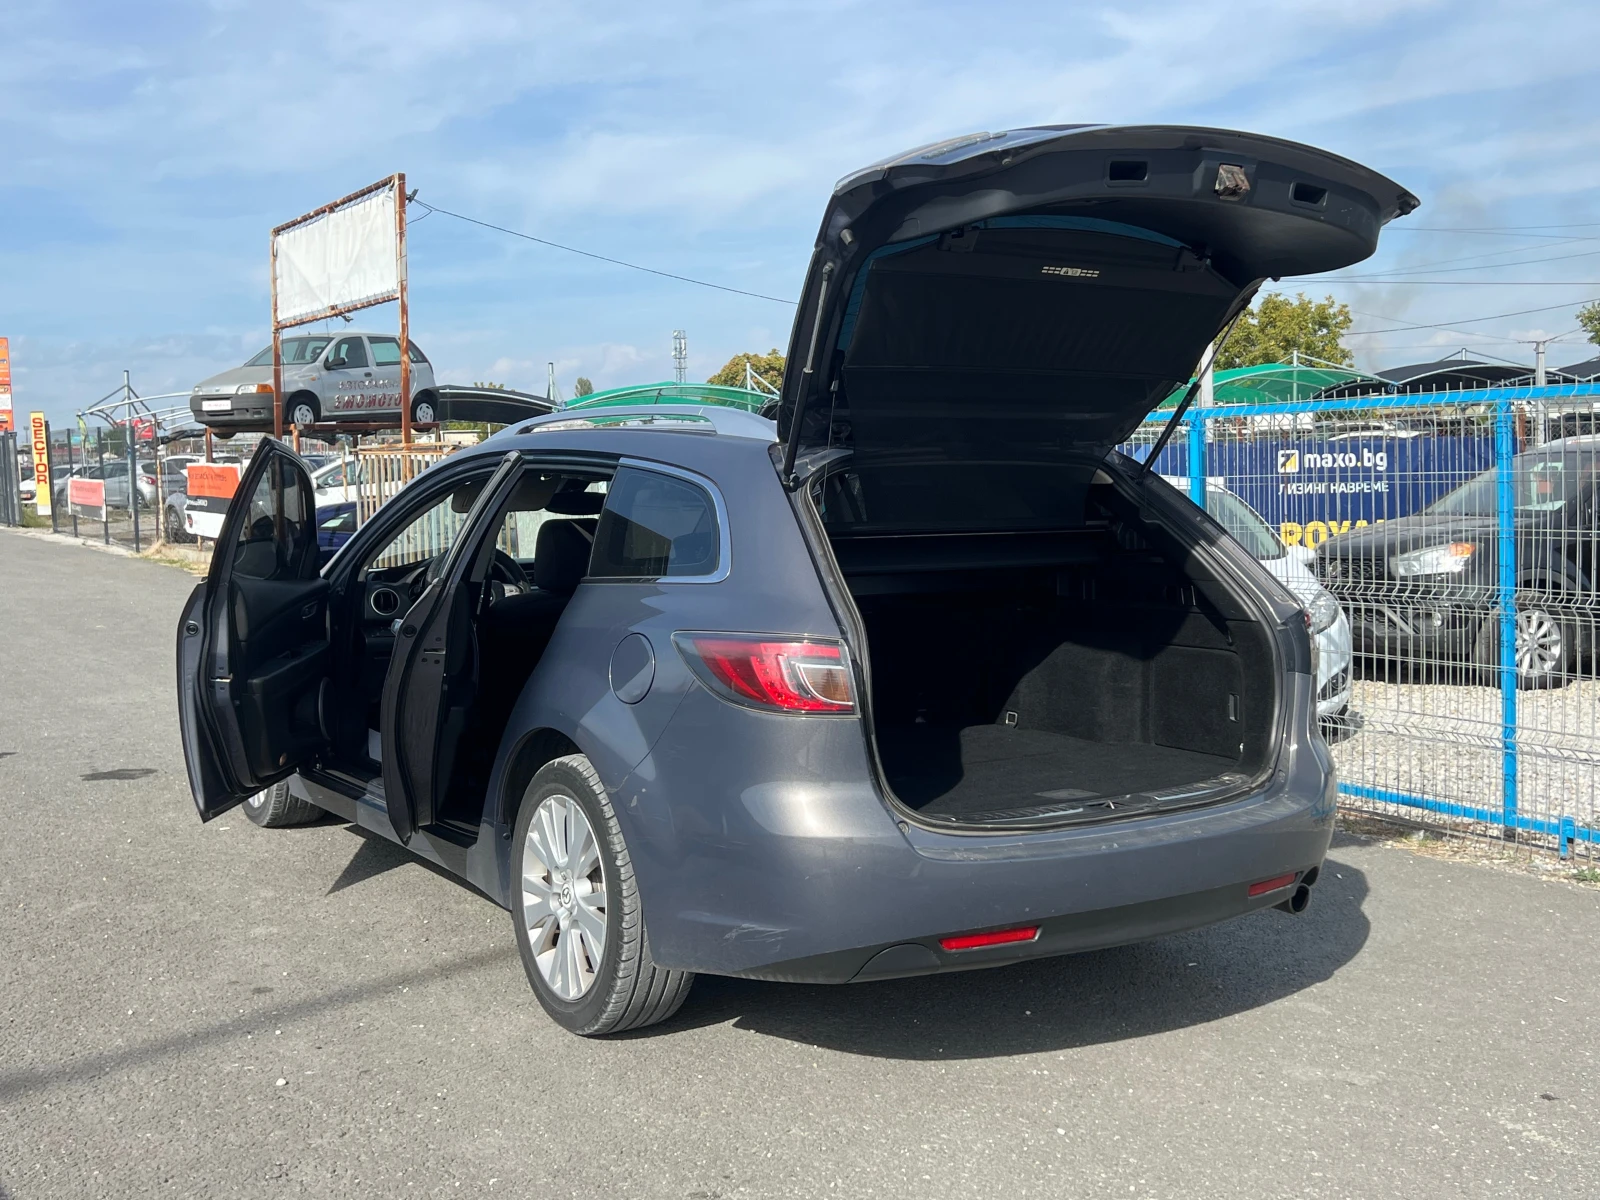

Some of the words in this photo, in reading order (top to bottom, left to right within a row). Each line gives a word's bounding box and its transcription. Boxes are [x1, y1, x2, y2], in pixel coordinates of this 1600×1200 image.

[32, 417, 47, 484] SECTOR
[1304, 448, 1388, 471] maxo.bg
[1330, 481, 1389, 494] НАВРЕМЕ
[1280, 519, 1386, 550] ROY
